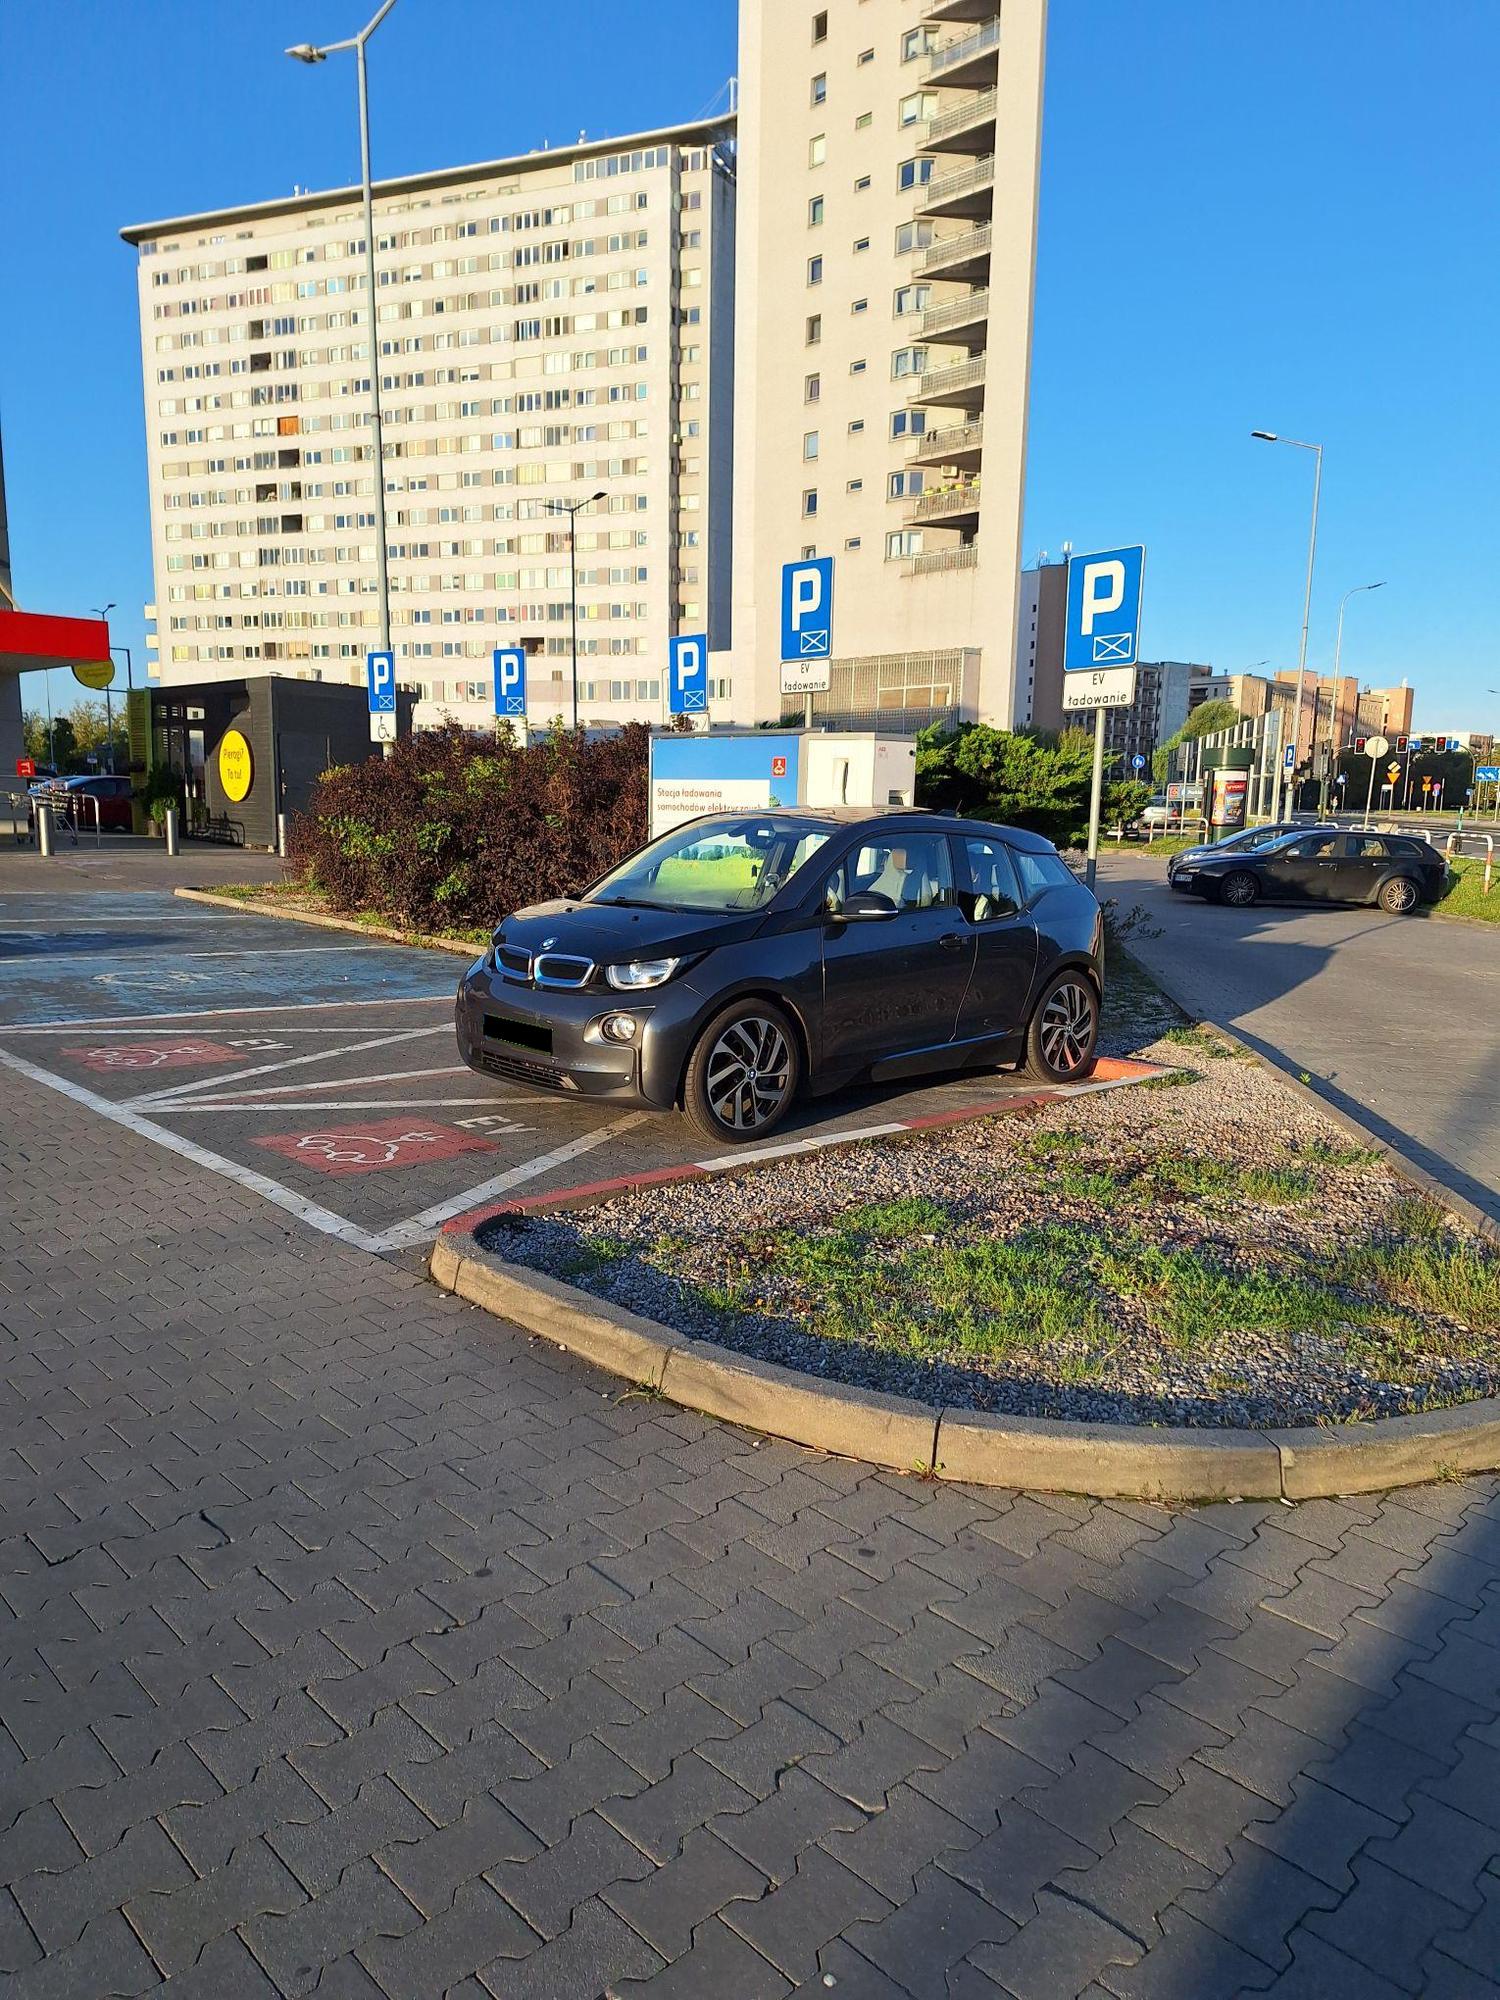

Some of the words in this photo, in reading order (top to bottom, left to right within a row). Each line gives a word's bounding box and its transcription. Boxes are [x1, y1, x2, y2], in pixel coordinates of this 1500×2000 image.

[792, 568, 821, 631] P
[1081, 560, 1125, 635] P
[677, 641, 699, 690] P
[800, 663, 810, 673] EV
[373, 657, 389, 694] P
[500, 654, 519, 696] P
[1092, 673, 1105, 685] EV
[784, 680, 826, 691] ładowanie
[1068, 692, 1127, 706] ładowanie
[657, 787, 680, 799] Stacja
[681, 788, 722, 798] ładowania
[226, 1038, 294, 1051] EV
[452, 1115, 541, 1135] EV
